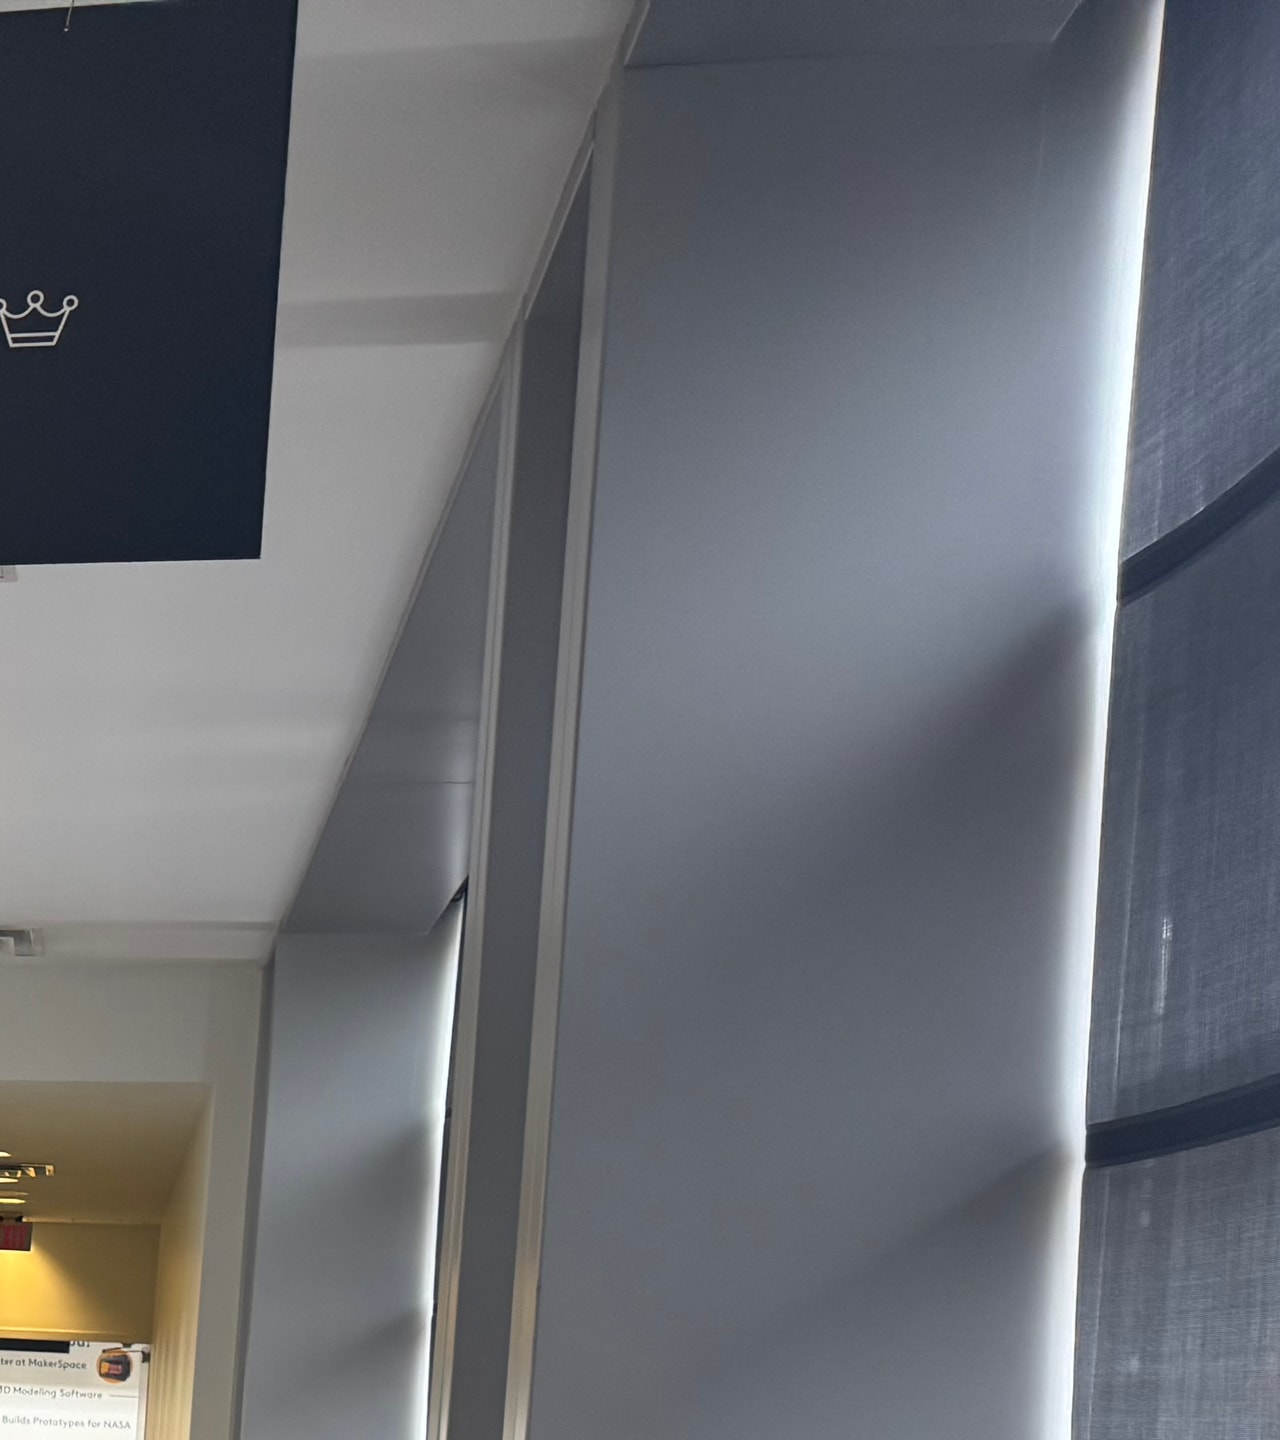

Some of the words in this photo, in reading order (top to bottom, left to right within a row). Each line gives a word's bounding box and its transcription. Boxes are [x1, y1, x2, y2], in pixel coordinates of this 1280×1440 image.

[15, 1357, 25, 1367] at
[28, 1358, 87, 1371] MakerSpace
[13, 1386, 57, 1399] Modeling
[60, 1388, 102, 1399] Software
[2, 1415, 31, 1425] Builds
[33, 1416, 85, 1429] Prototypes
[87, 1418, 101, 1428] for
[103, 1419, 132, 1430] NASA
